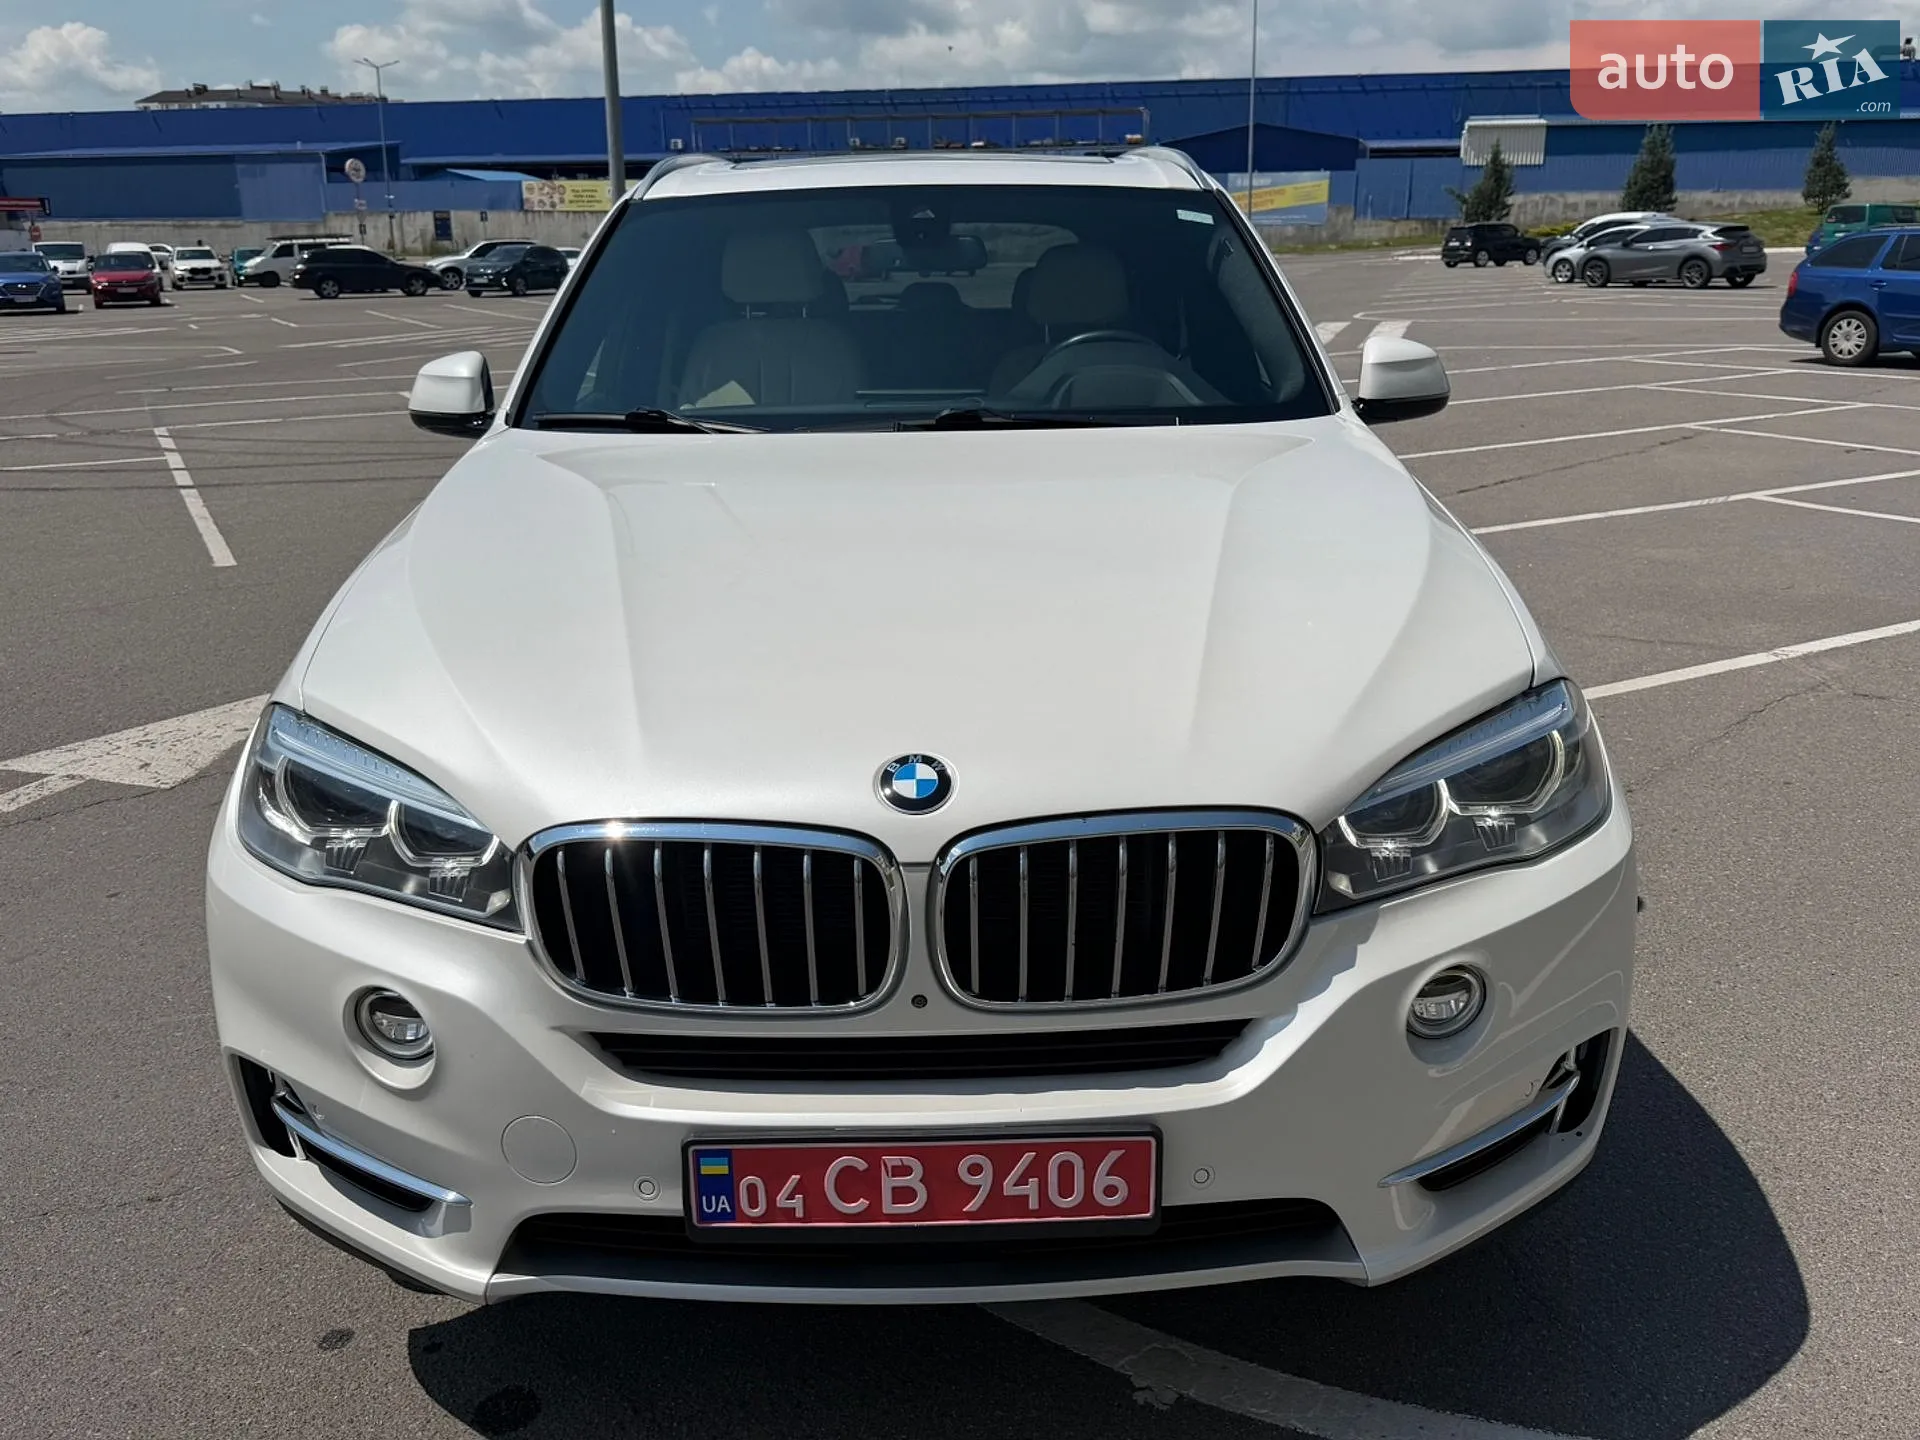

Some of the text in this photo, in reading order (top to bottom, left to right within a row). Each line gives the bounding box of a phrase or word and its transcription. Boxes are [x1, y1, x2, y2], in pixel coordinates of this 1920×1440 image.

[886, 755, 947, 773] BMW
[738, 1175, 804, 1218] 04
[957, 1149, 1129, 1212] 9406
[702, 1195, 731, 1214] UA
